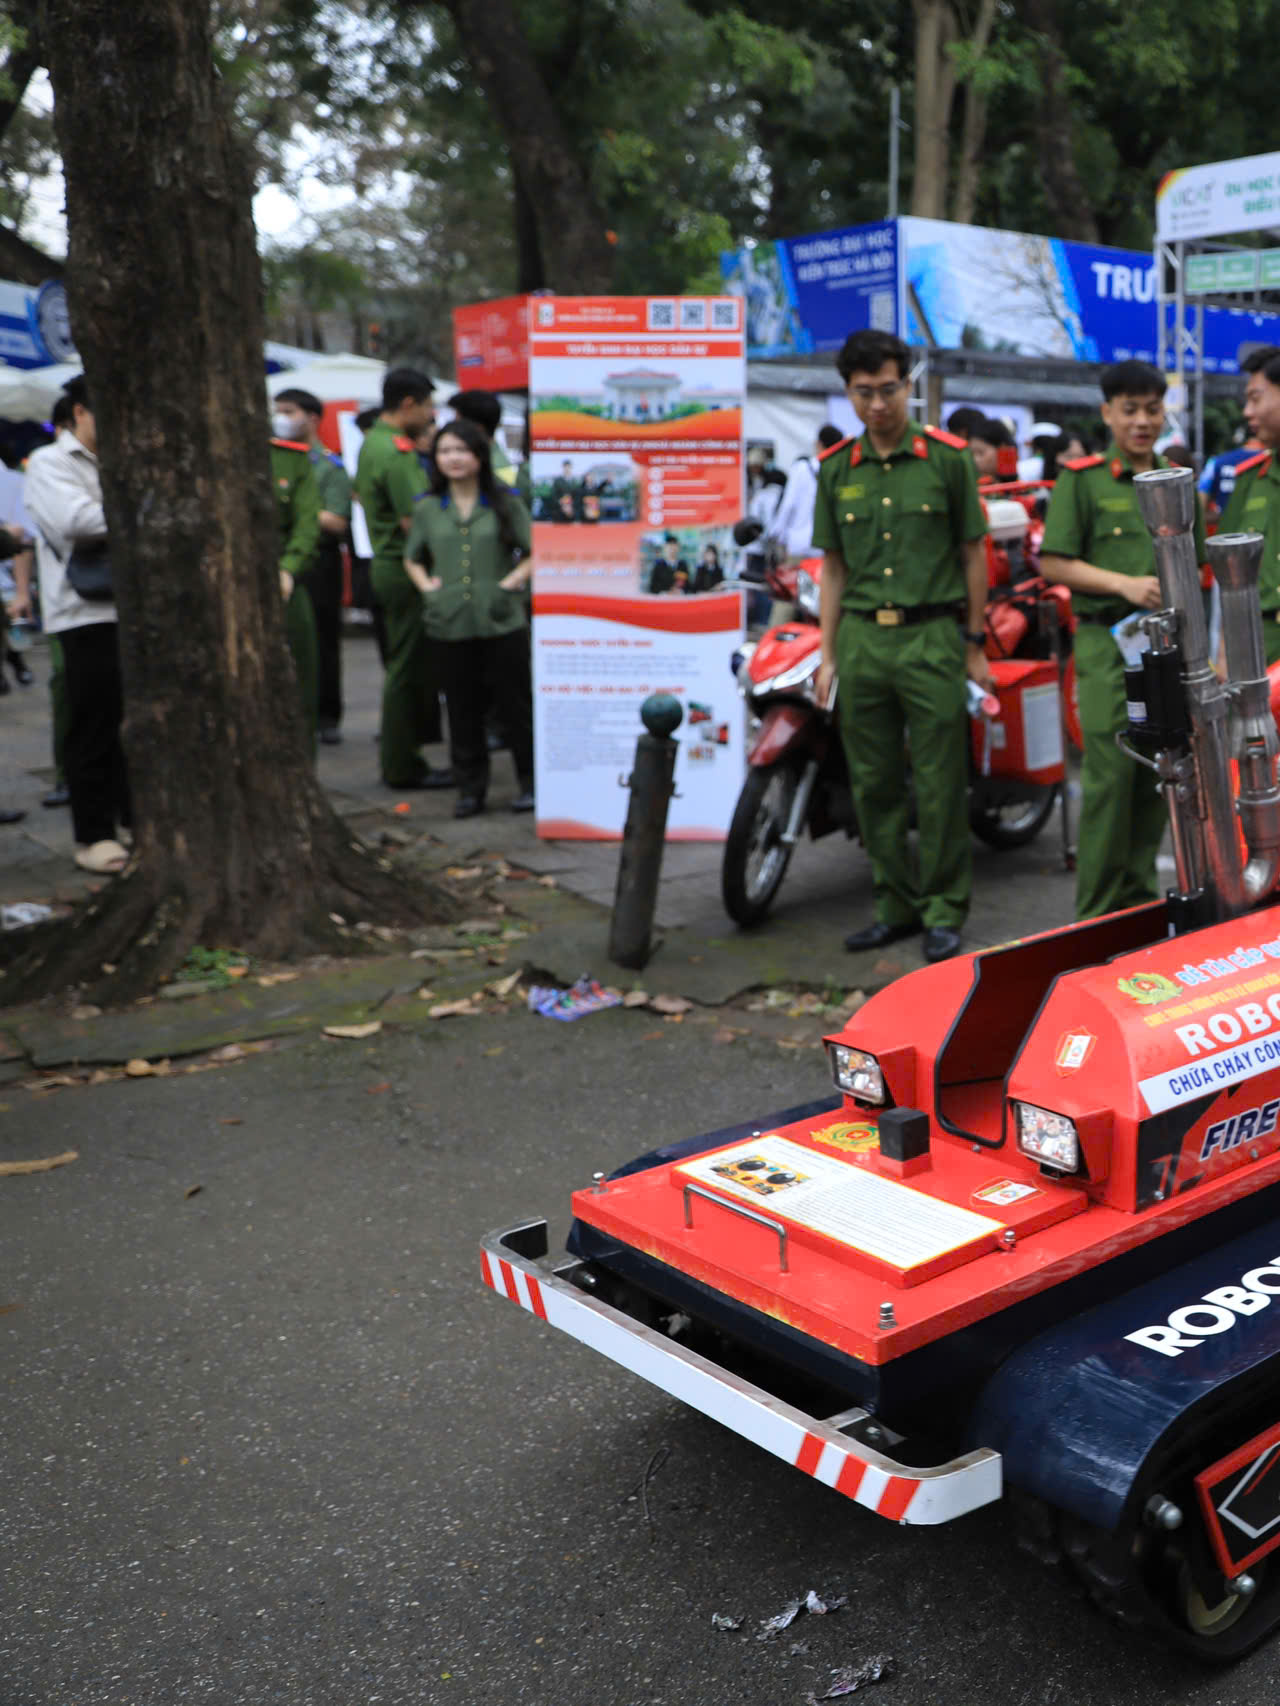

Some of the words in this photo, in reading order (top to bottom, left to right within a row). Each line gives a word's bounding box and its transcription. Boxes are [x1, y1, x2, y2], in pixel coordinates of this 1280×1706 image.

[1174, 963, 1211, 985] ĐỀ
[1198, 957, 1239, 978] TÀI
[1227, 946, 1267, 969] CẤP
[1168, 1067, 1215, 1096] CHỮA
[1213, 1050, 1254, 1080] CHÁY
